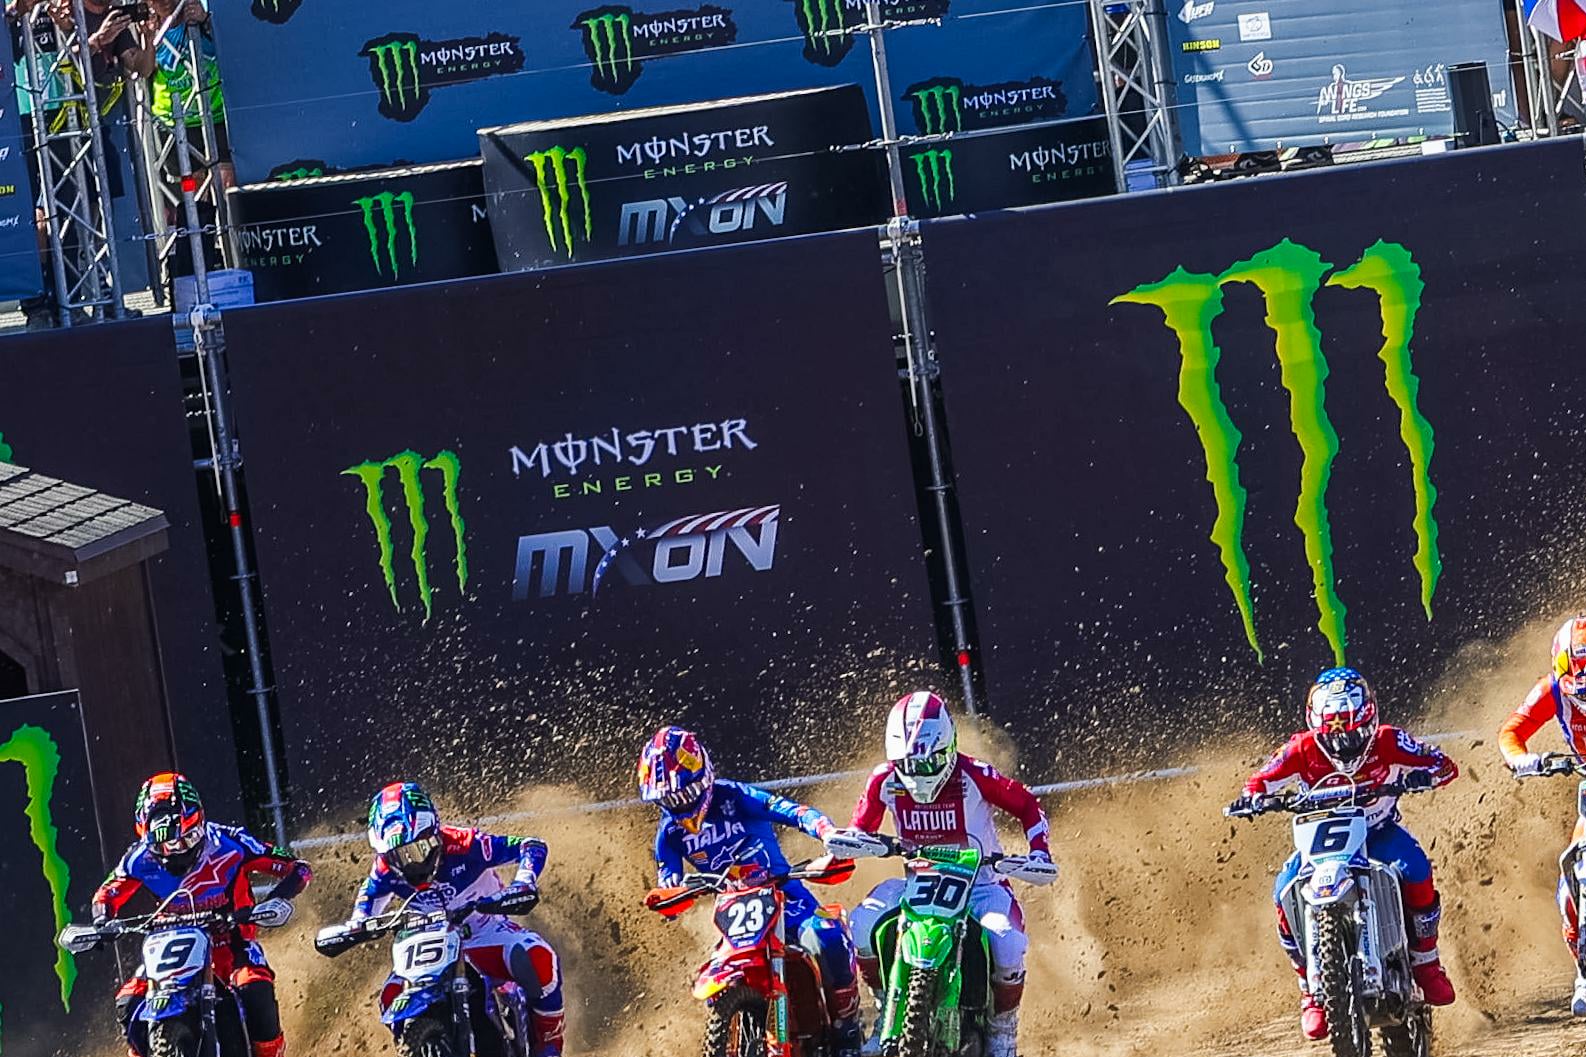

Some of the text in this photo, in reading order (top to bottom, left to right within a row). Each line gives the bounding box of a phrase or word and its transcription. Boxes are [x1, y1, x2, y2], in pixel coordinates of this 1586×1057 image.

[633, 13, 727, 38] MONSTER
[649, 31, 715, 47] ENERGY
[420, 41, 514, 66] MONSTER
[436, 59, 502, 74] ENERGY
[963, 85, 1057, 110] MONSTER
[615, 125, 775, 165] MONSTER
[643, 156, 754, 179] ENERGY
[1031, 164, 1105, 184] ENERG
[508, 417, 758, 478] MONSTER
[553, 464, 723, 498] ENERGY
[1310, 818, 1353, 856] 6
[908, 873, 970, 911] 30
[727, 898, 764, 937] 23
[155, 937, 198, 974] 9
[404, 938, 445, 971] 15
